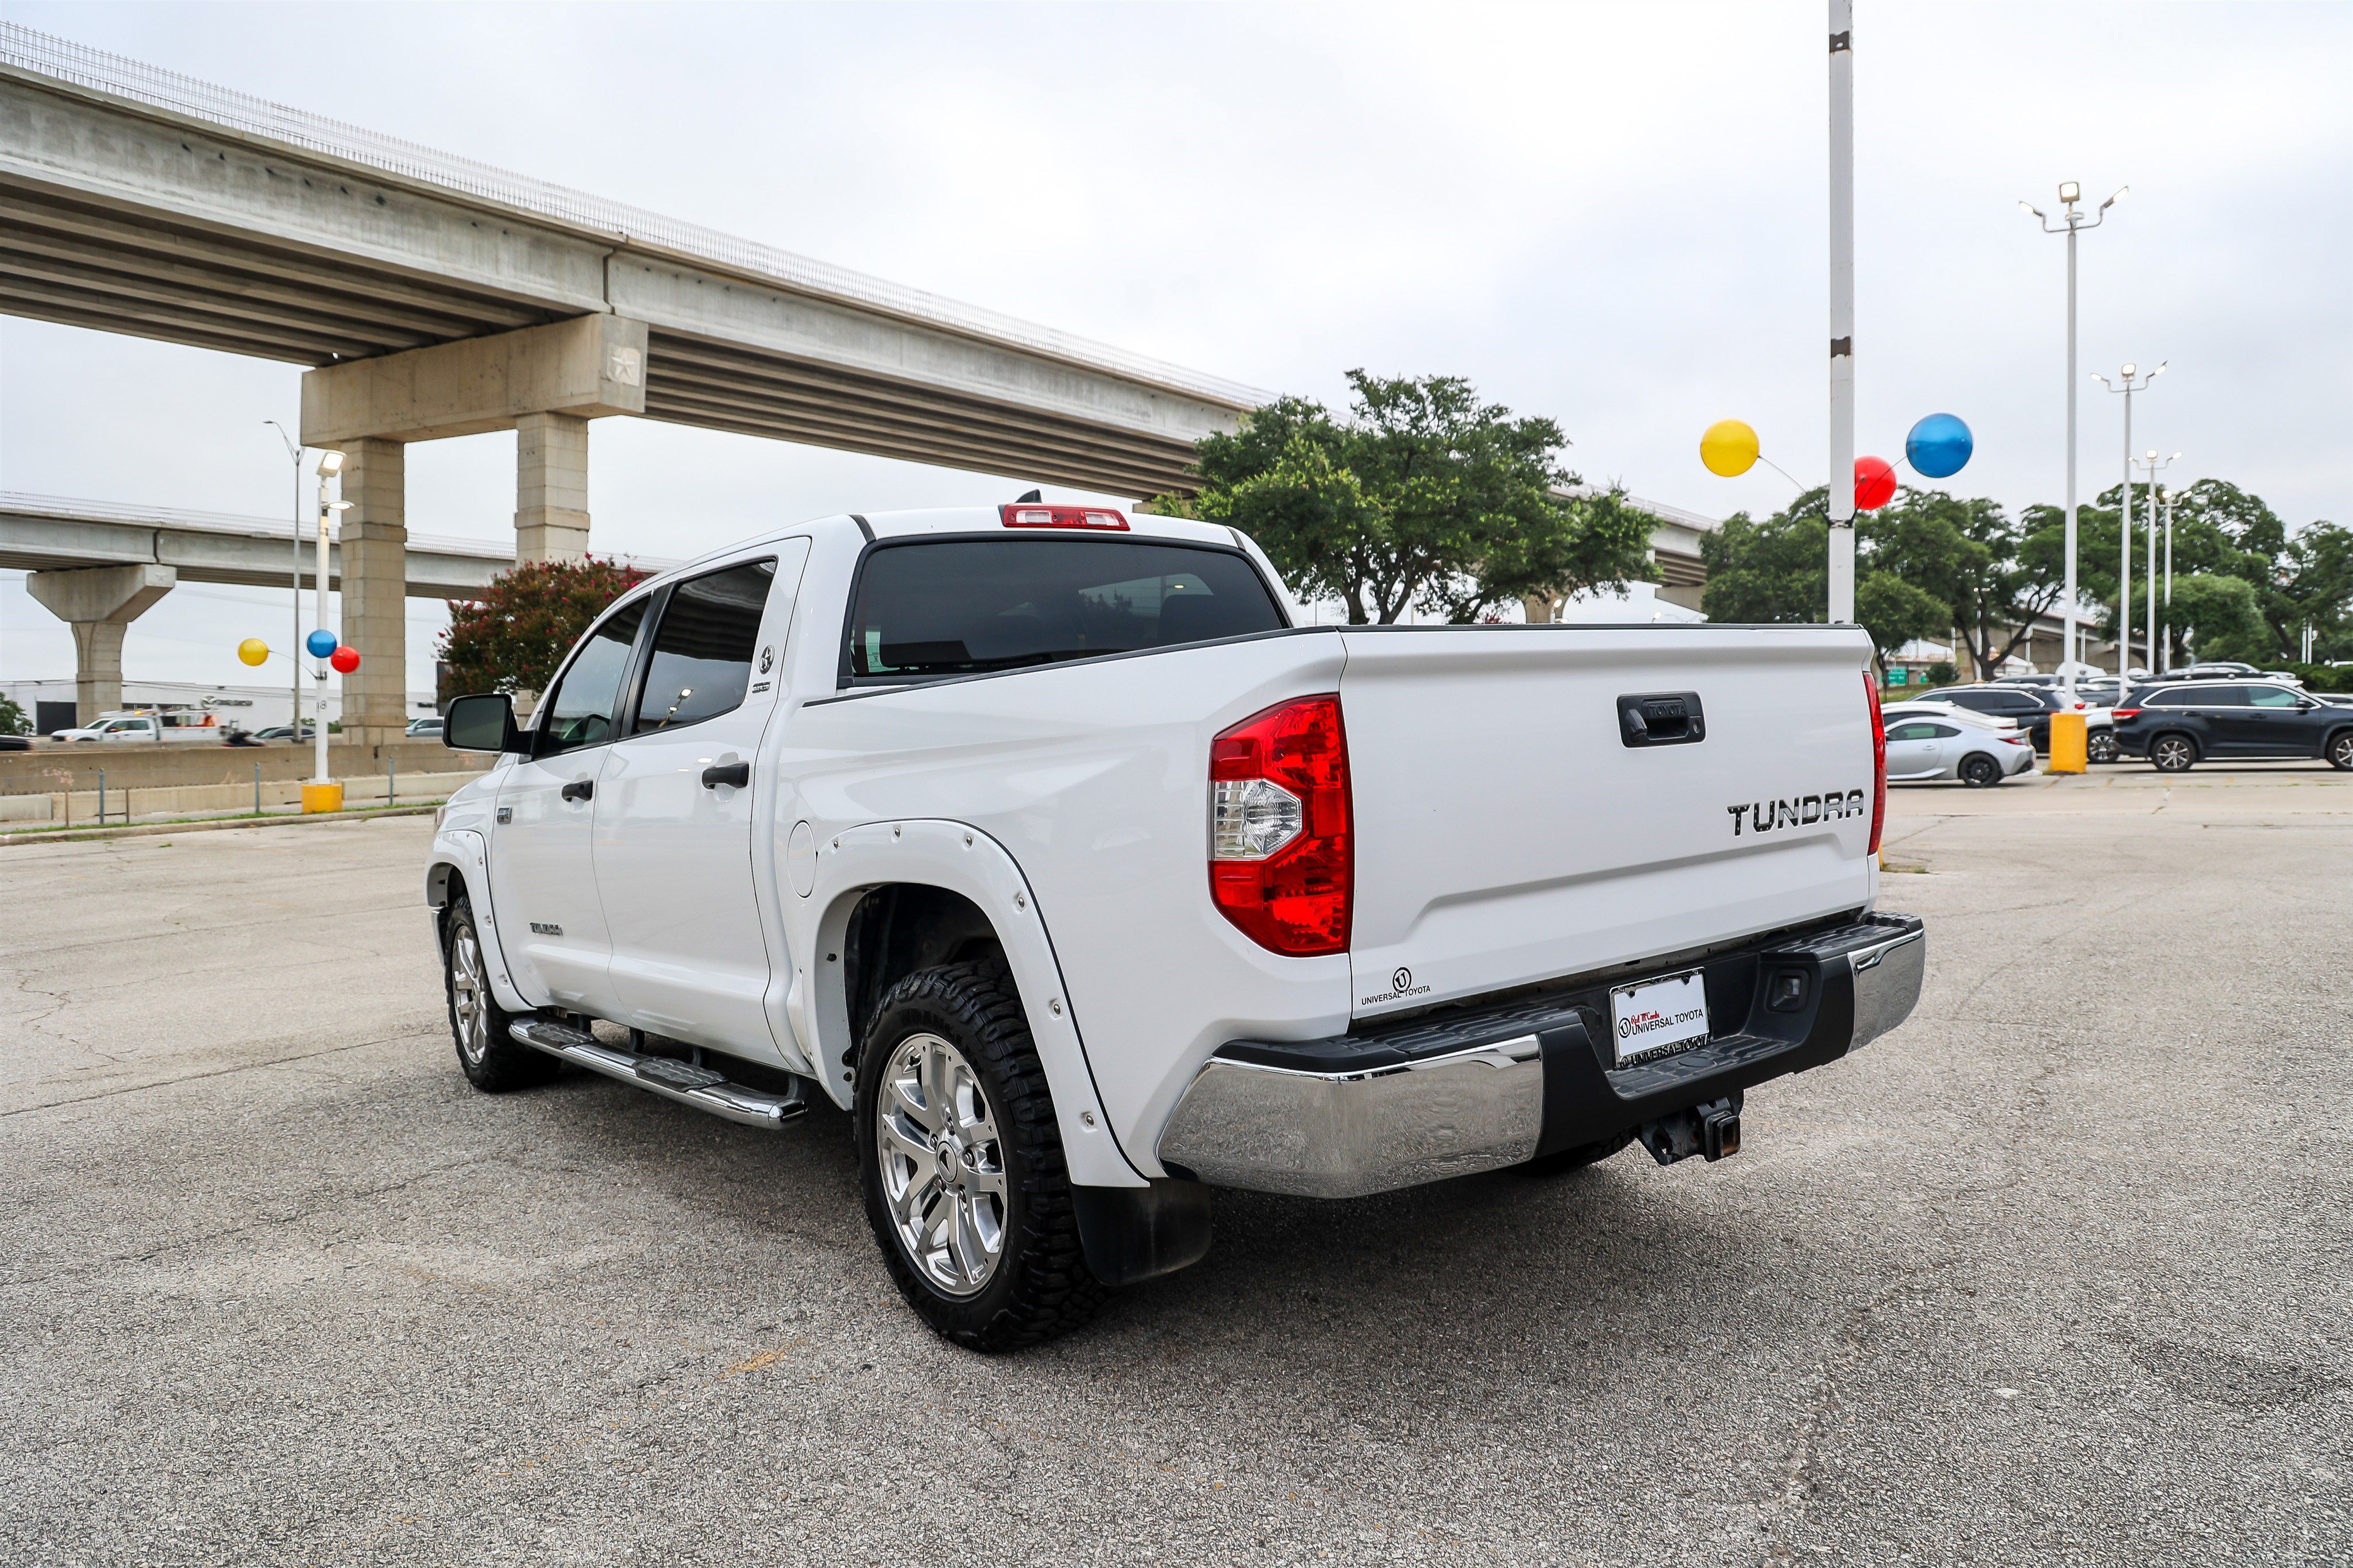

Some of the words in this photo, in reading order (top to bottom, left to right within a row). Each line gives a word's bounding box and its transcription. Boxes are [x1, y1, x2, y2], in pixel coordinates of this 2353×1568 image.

[1649, 702, 1687, 717] TOYOTA
[1727, 789, 1864, 836] TUNDRA
[1361, 991, 1402, 1006] UNIVERSAL
[1405, 985, 1431, 997] TOYOTA
[1632, 1016, 1675, 1036] UNIVERSAL
[1675, 1009, 1704, 1024] TOYOTA
[1630, 1043, 1680, 1064] UNIVERSAL
[1679, 1034, 1712, 1052] TOYOTA
